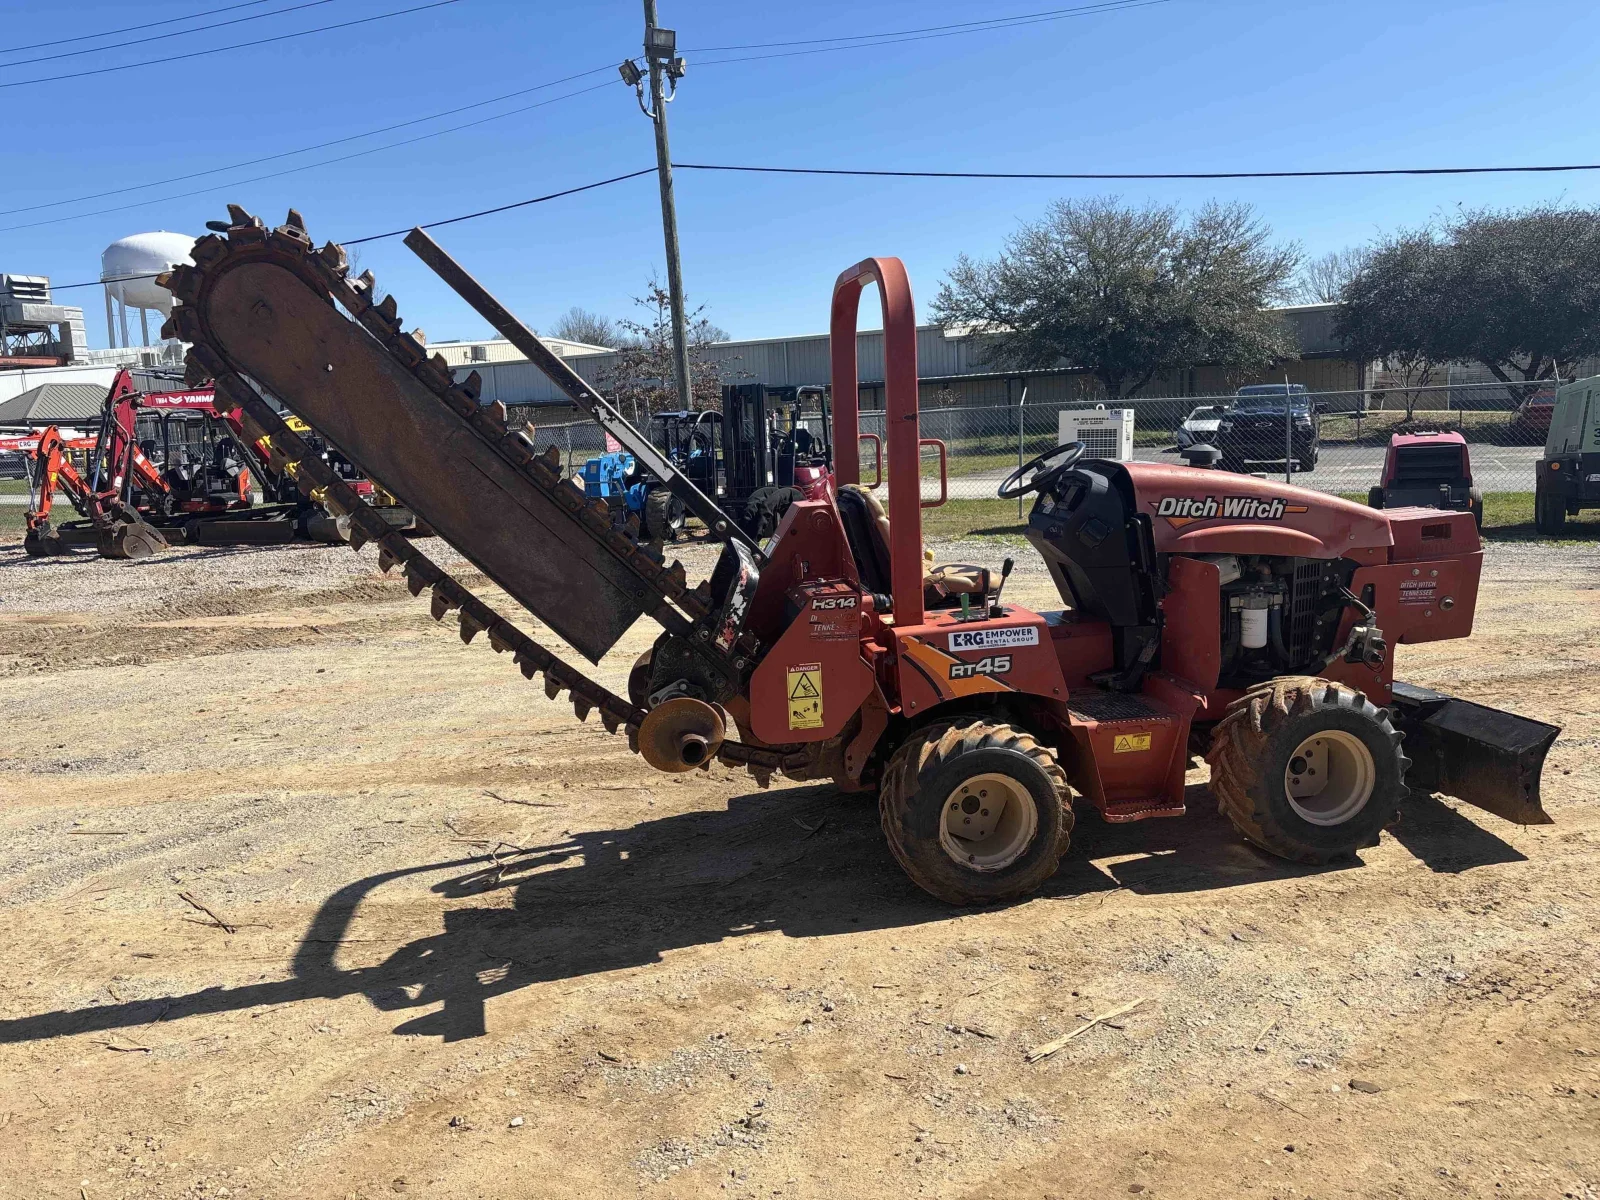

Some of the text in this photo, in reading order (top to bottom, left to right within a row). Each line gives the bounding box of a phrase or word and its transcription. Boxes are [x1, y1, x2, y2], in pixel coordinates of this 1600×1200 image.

[1157, 497, 1287, 519] Ditch Witch
[811, 597, 856, 610] H314
[953, 631, 985, 647] ERG
[985, 627, 1033, 639] EMPOWER
[951, 656, 1011, 678] RT45
